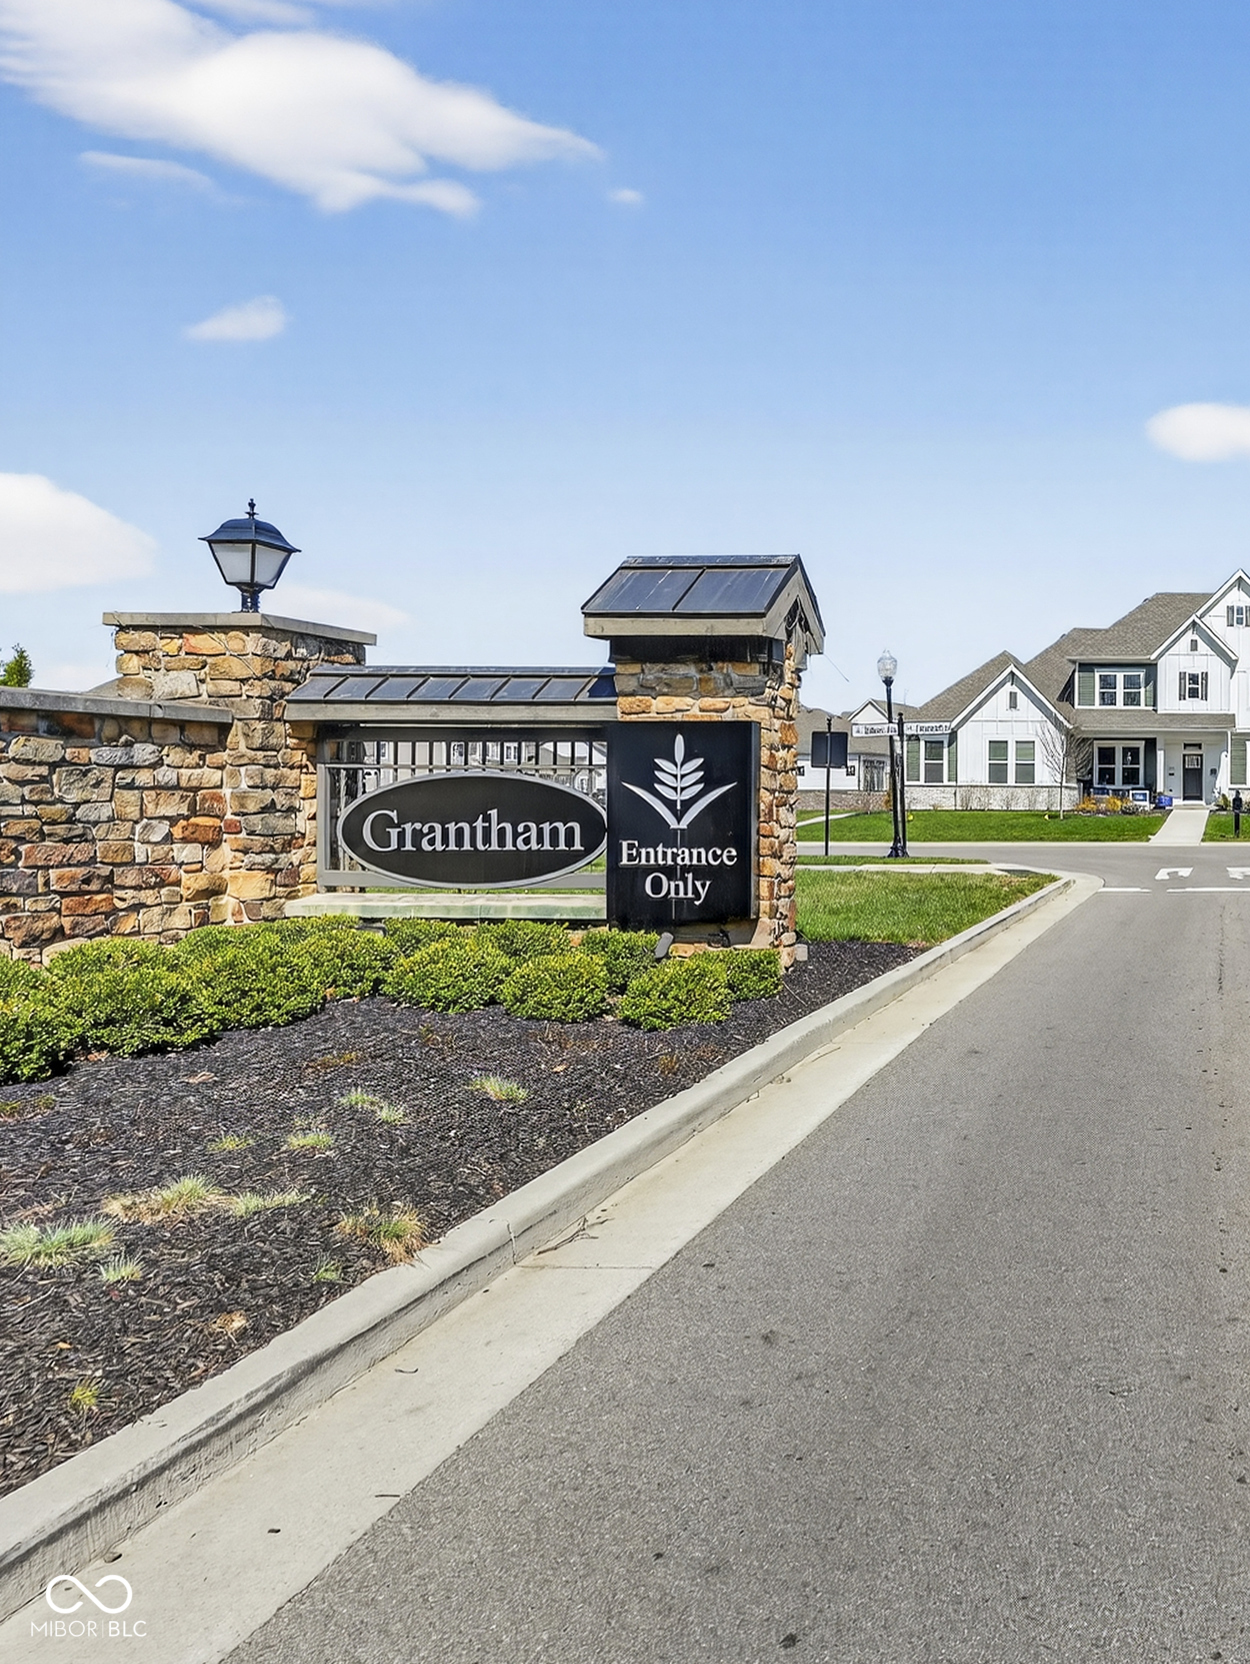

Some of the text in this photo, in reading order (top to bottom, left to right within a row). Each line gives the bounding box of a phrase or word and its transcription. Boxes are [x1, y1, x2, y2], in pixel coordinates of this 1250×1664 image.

[361, 808, 585, 853] Grantham
[619, 840, 738, 867] Entrance
[644, 873, 712, 905] Only
